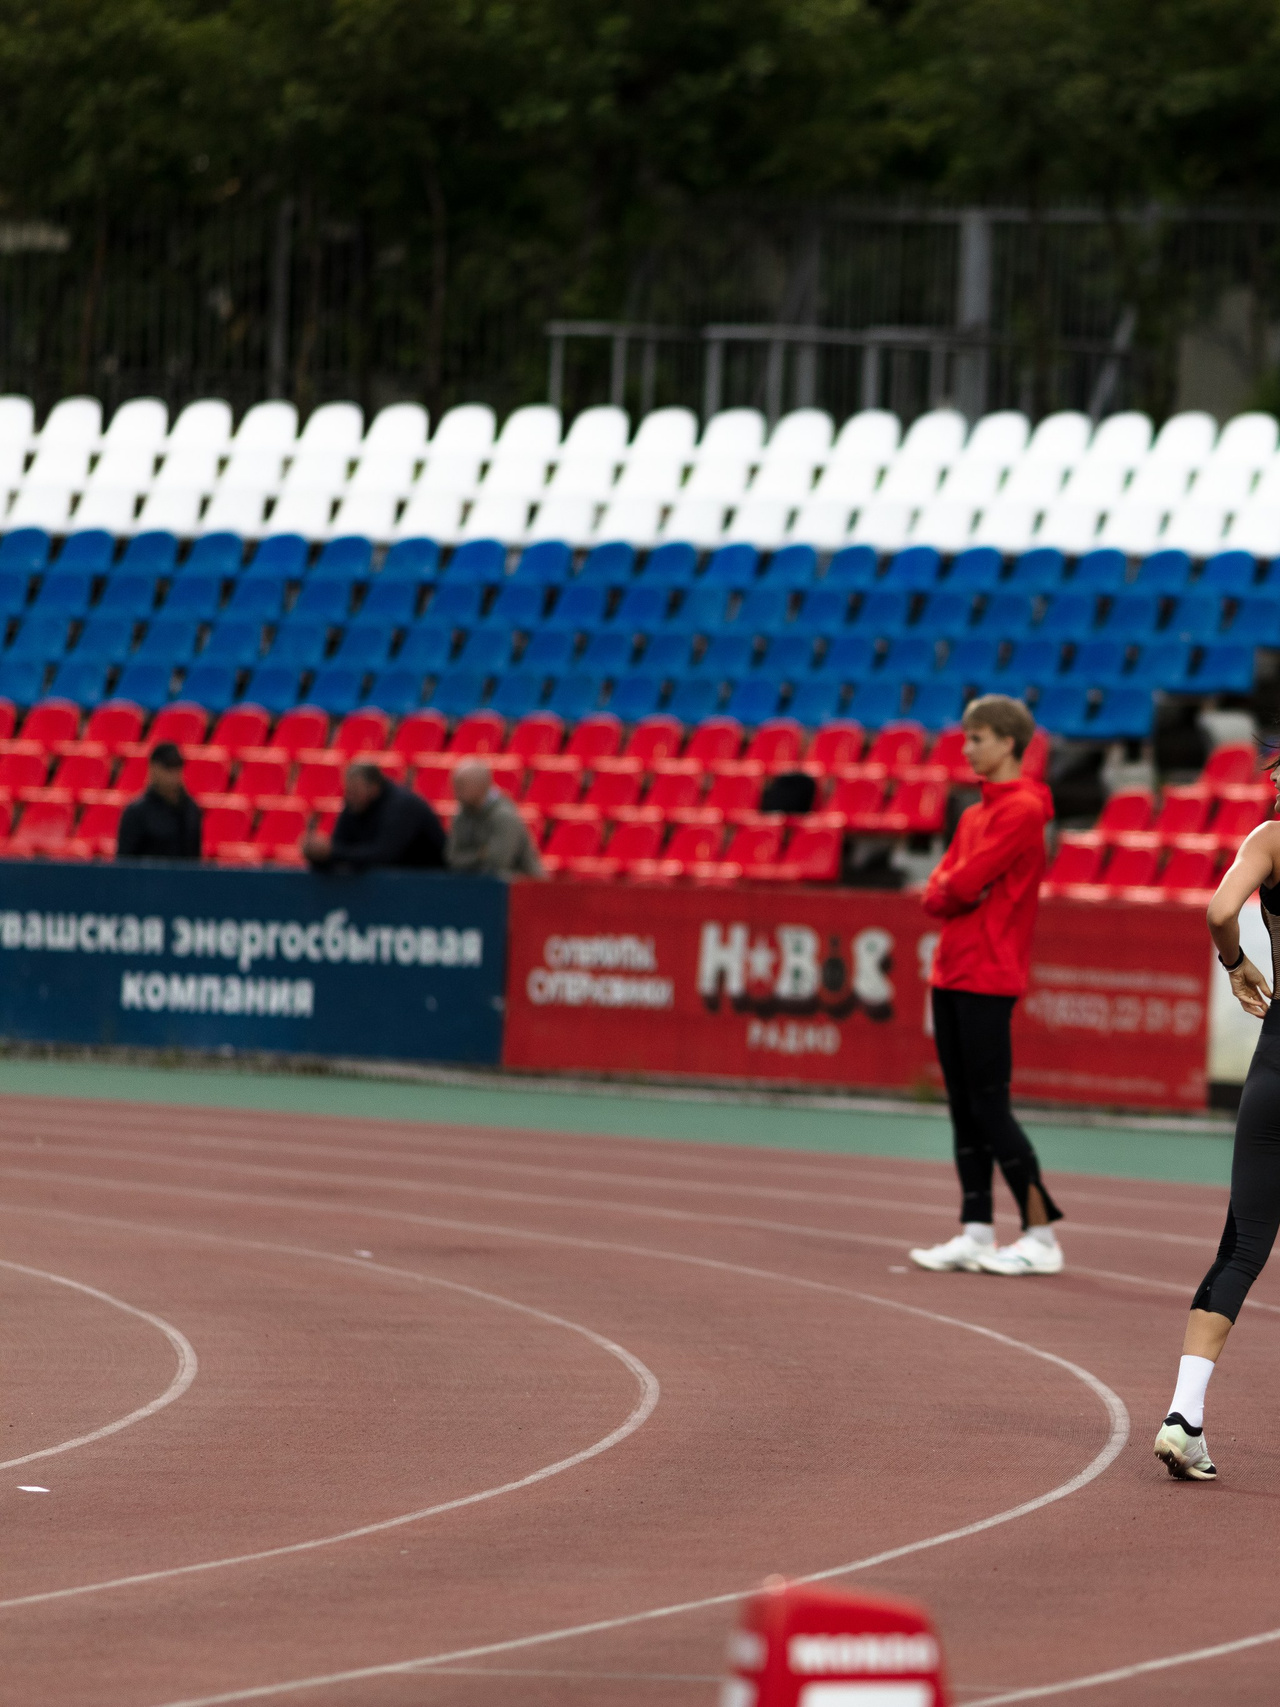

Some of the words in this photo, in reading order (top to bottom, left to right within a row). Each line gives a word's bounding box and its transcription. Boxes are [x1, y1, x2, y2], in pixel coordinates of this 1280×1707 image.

[0, 911, 164, 954] вашская
[172, 910, 483, 971] энергосбытовая
[121, 970, 315, 1017] компания
[748, 1022, 841, 1054] РАДИО
